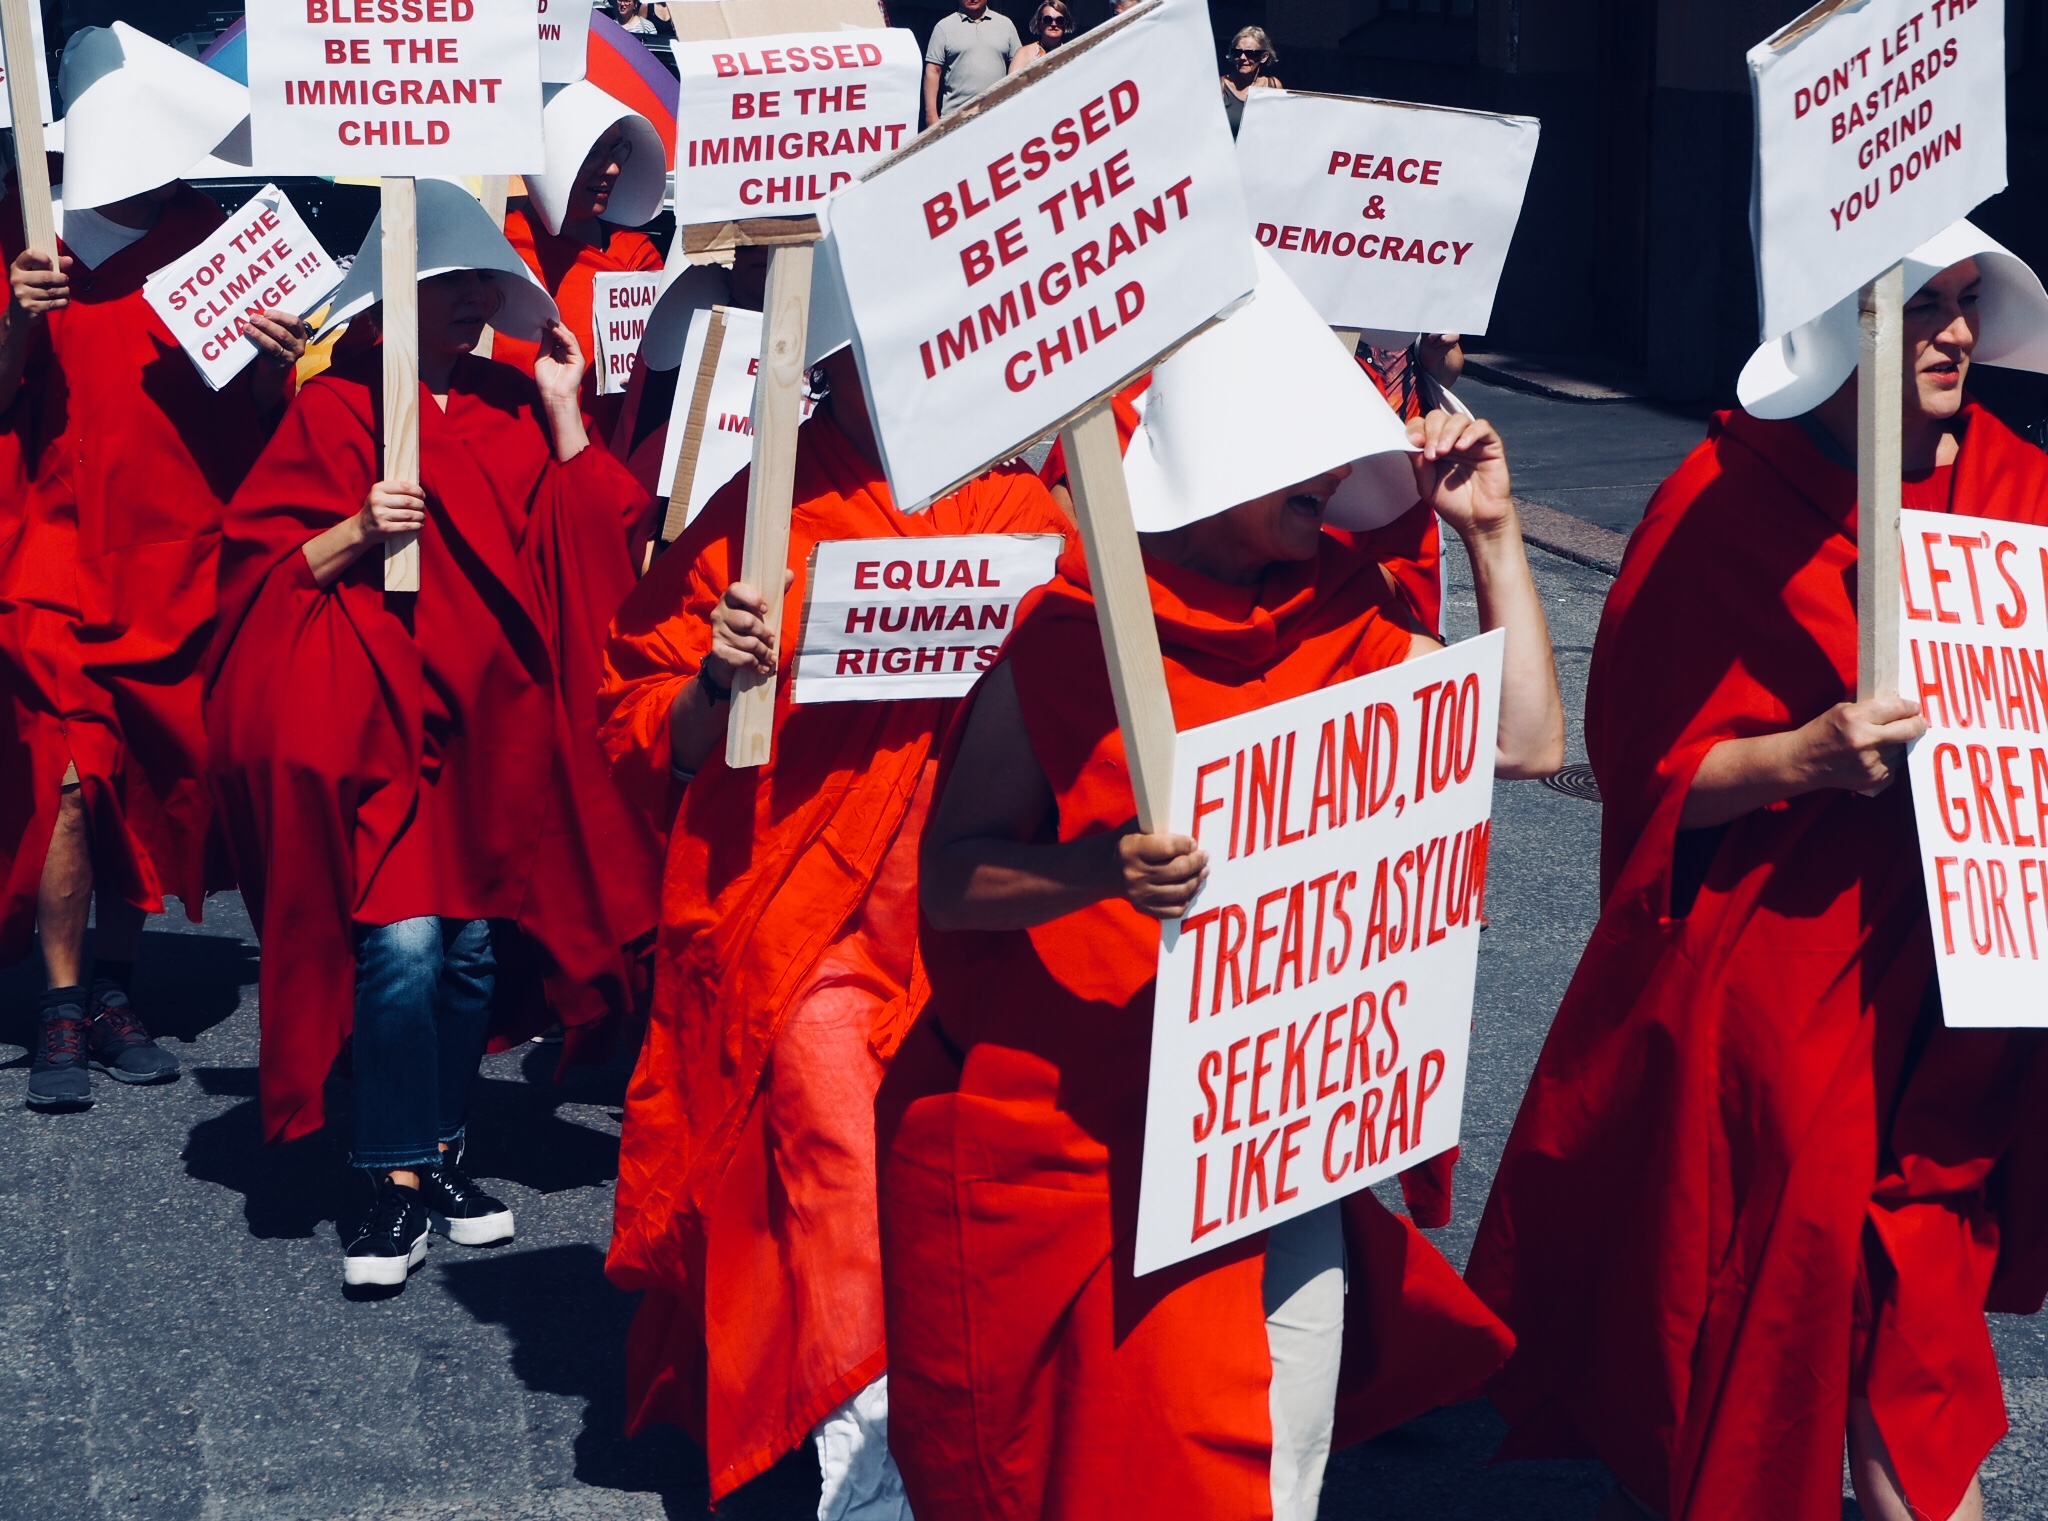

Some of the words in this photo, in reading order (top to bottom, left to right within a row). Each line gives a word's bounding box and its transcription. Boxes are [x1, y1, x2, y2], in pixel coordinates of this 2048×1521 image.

[307, 0, 474, 23] BLESSED
[325, 39, 370, 65] BE
[384, 38, 459, 64] THE
[285, 79, 502, 105] IMMIGRANT
[712, 43, 883, 78] BLESSED
[1794, 47, 1872, 120] DON'T
[1882, 12, 1924, 66] LET
[1831, 37, 1958, 144] BASTARDS
[338, 120, 450, 146] CHILD
[732, 91, 781, 120] BE
[794, 84, 867, 115] THE
[1858, 99, 1933, 170] GRIND
[689, 123, 907, 167] IMMIGRANT
[923, 79, 1140, 240] BLESSED
[1327, 150, 1443, 186] PEACE
[1830, 177, 1880, 232] YOU
[1890, 123, 1963, 194] DOWN
[959, 217, 1029, 288] BE
[1038, 149, 1136, 235] THE
[1255, 222, 1475, 266] DEMOCRACY
[1362, 194, 1386, 220] &
[168, 253, 226, 311] STOP
[229, 208, 281, 254] THE
[194, 238, 293, 328] CLIMATE
[295, 252, 322, 279] !!!
[919, 175, 1193, 380] IMMIGRANT
[1004, 280, 1146, 393] CHILD
[854, 559, 1001, 591] EQUAL
[1900, 531, 2028, 629] LET'S
[845, 604, 1009, 633] HUMAN
[835, 644, 1000, 675] RIGHTS
[1192, 702, 1406, 861] FINLAND,
[1413, 672, 1479, 804] TOO
[1181, 870, 1357, 1023] TREATS
[1360, 817, 1492, 971] ASYLUM
[1934, 856, 2021, 959] FOR
[1193, 980, 1408, 1143] SEEKERS
[1191, 1115, 1311, 1244] LIKE
[1322, 1048, 1446, 1183] CRAP
